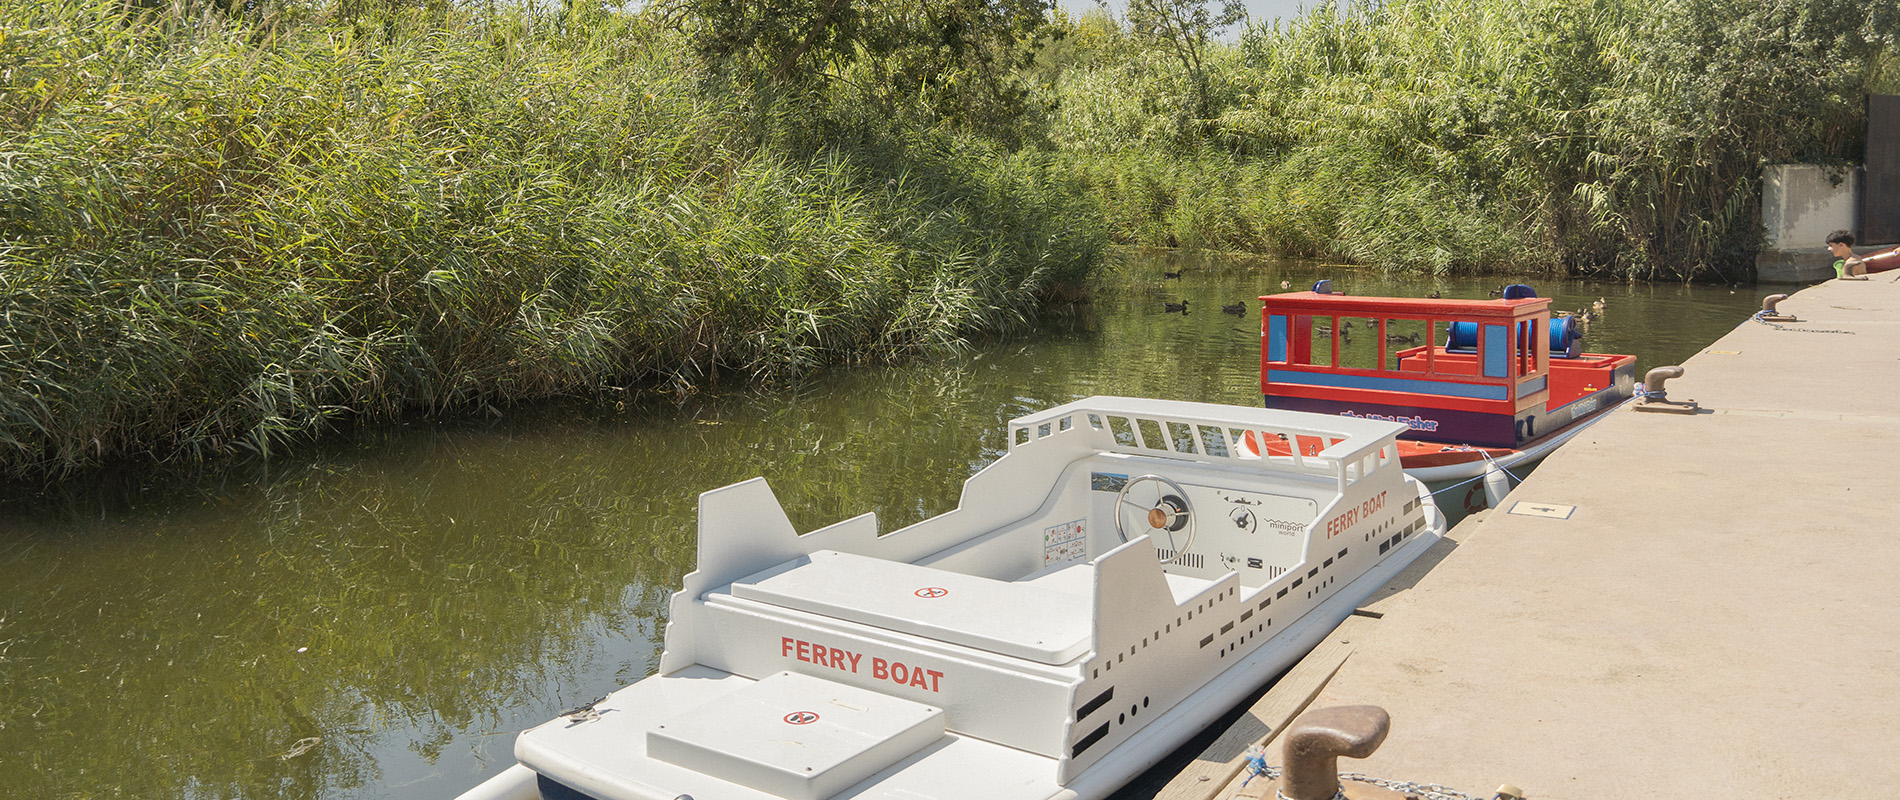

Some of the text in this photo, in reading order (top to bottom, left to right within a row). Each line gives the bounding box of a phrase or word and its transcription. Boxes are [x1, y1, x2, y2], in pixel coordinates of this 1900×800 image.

[1397, 416, 1438, 431] Fisher
[1269, 522, 1304, 533] miniport
[1327, 490, 1387, 540] FERRY BOAT
[781, 636, 944, 693] FERRY BOAT
